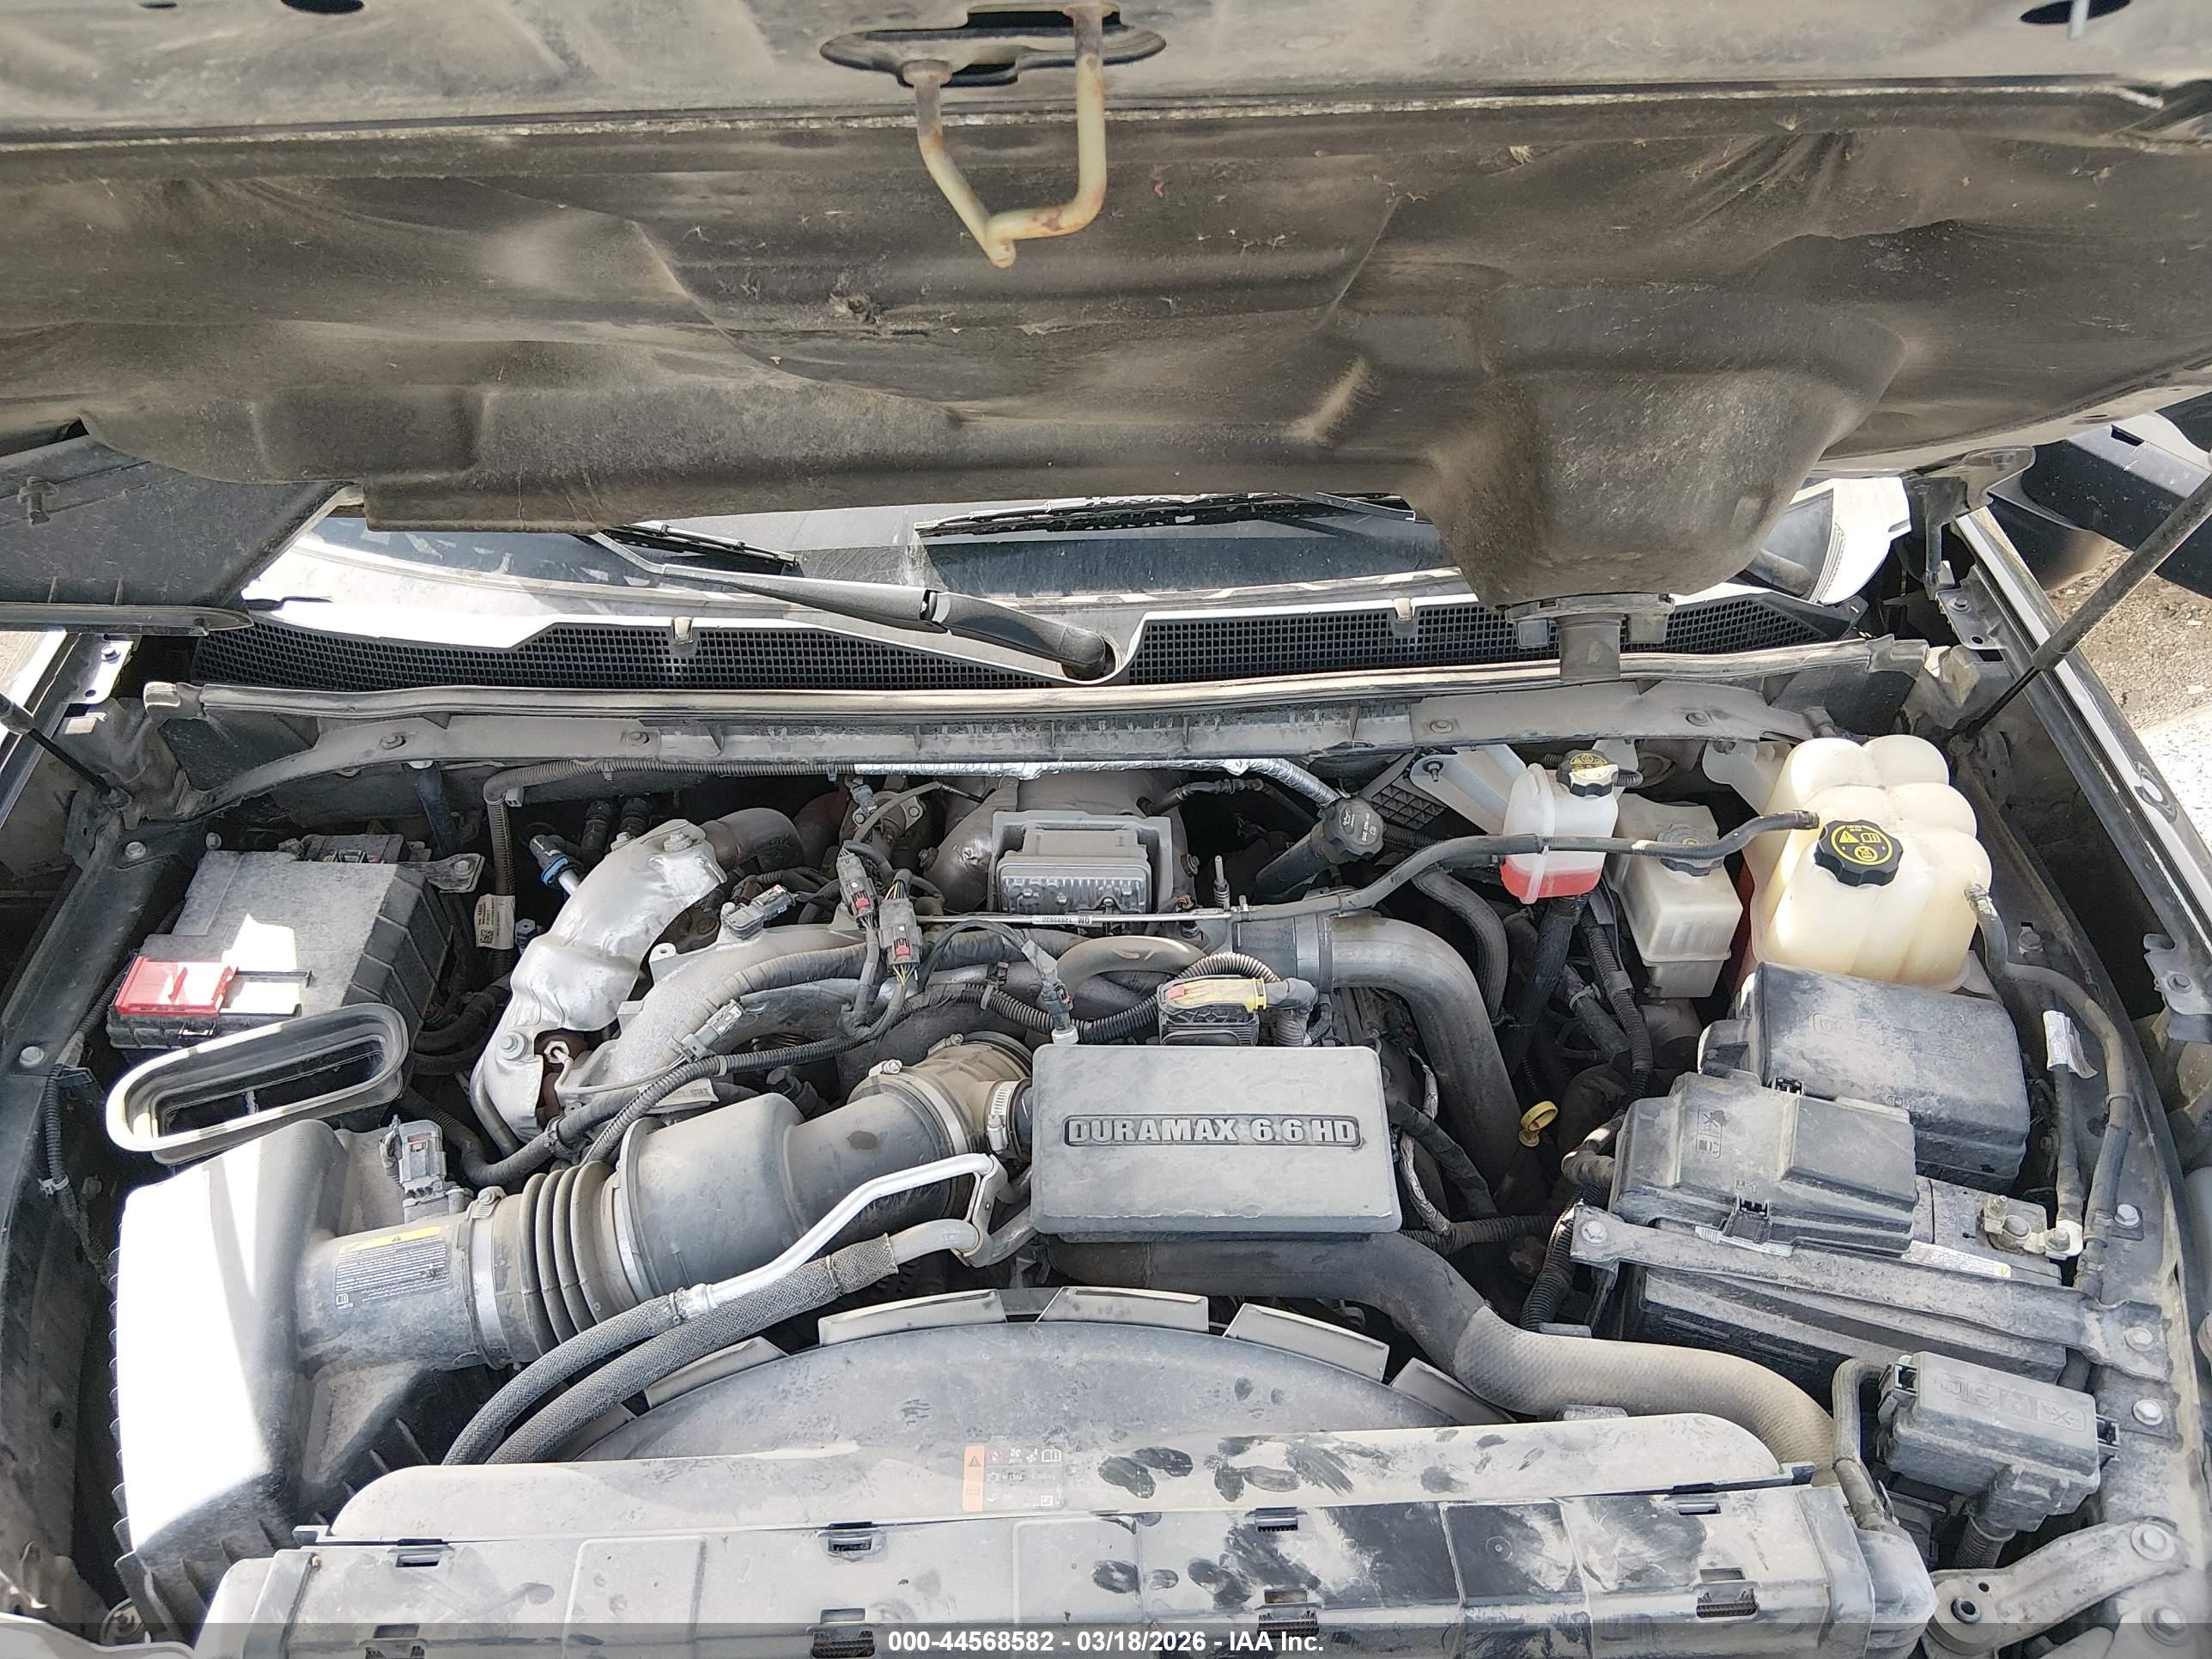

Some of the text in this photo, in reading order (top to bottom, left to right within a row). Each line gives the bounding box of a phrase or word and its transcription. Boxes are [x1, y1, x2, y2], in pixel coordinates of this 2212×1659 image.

[1067, 1118, 1357, 1144] DURAMAX 6.6 HD
